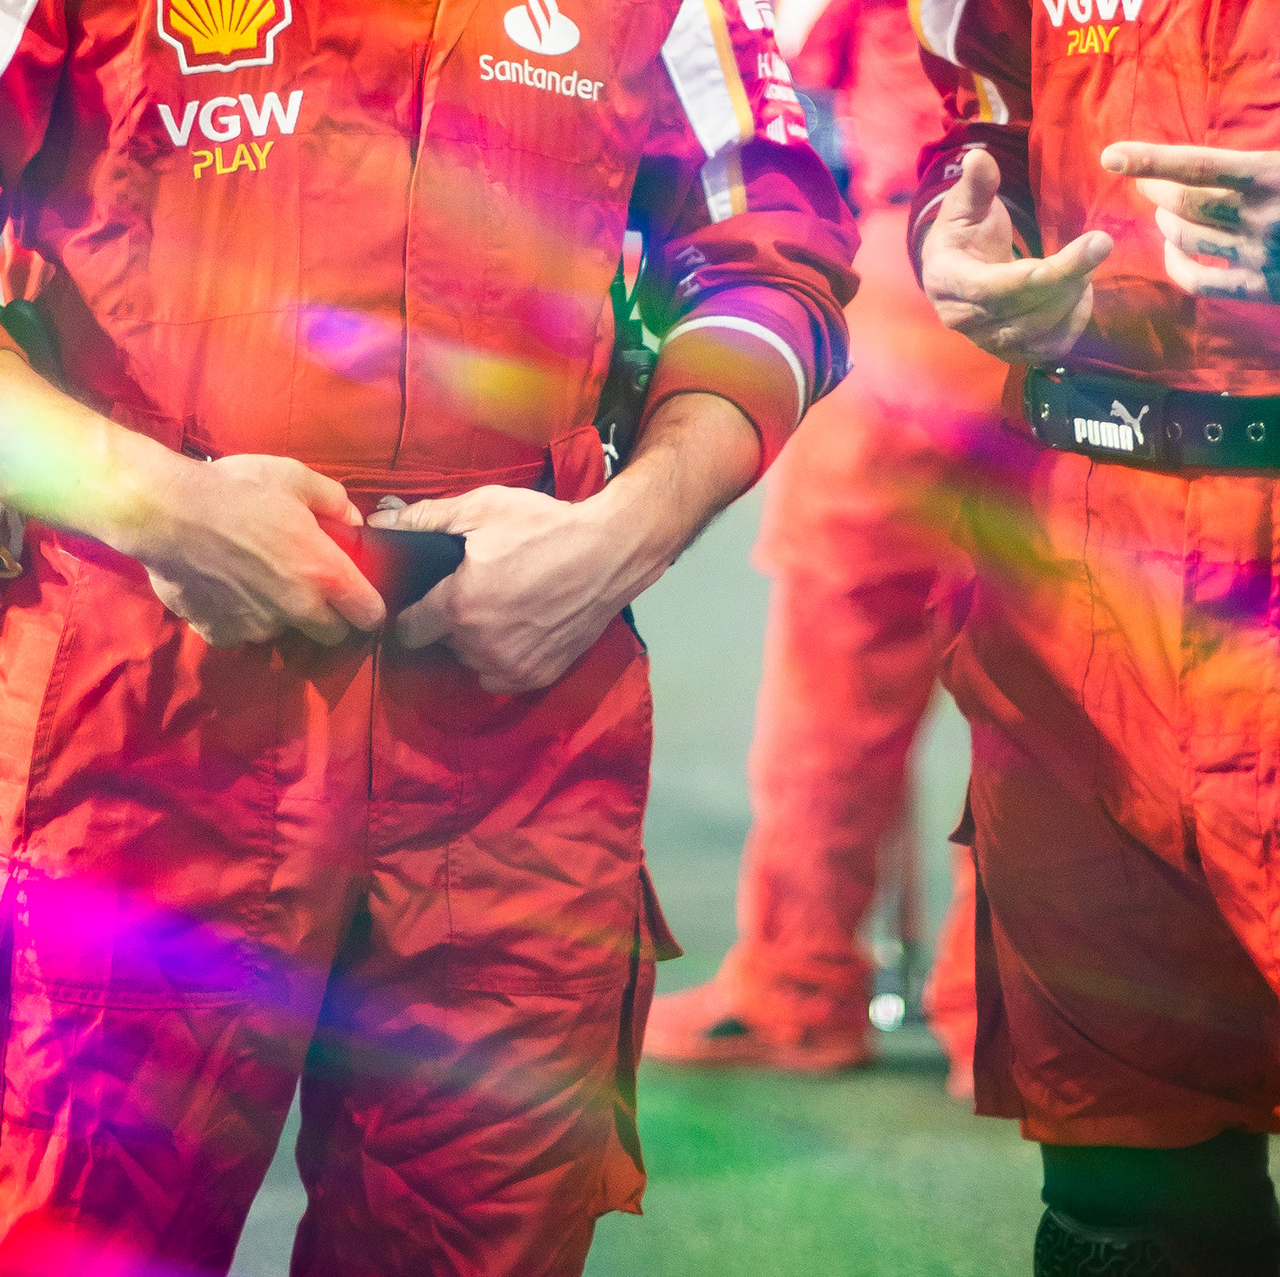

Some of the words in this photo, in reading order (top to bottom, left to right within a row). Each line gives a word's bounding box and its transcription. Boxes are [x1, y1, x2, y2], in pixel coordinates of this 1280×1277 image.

[1066, 25, 1120, 57] PLAY
[478, 55, 605, 102] Santander
[157, 90, 304, 148] VGW
[191, 140, 275, 180] PLAY
[1073, 416, 1135, 452] PUMA
